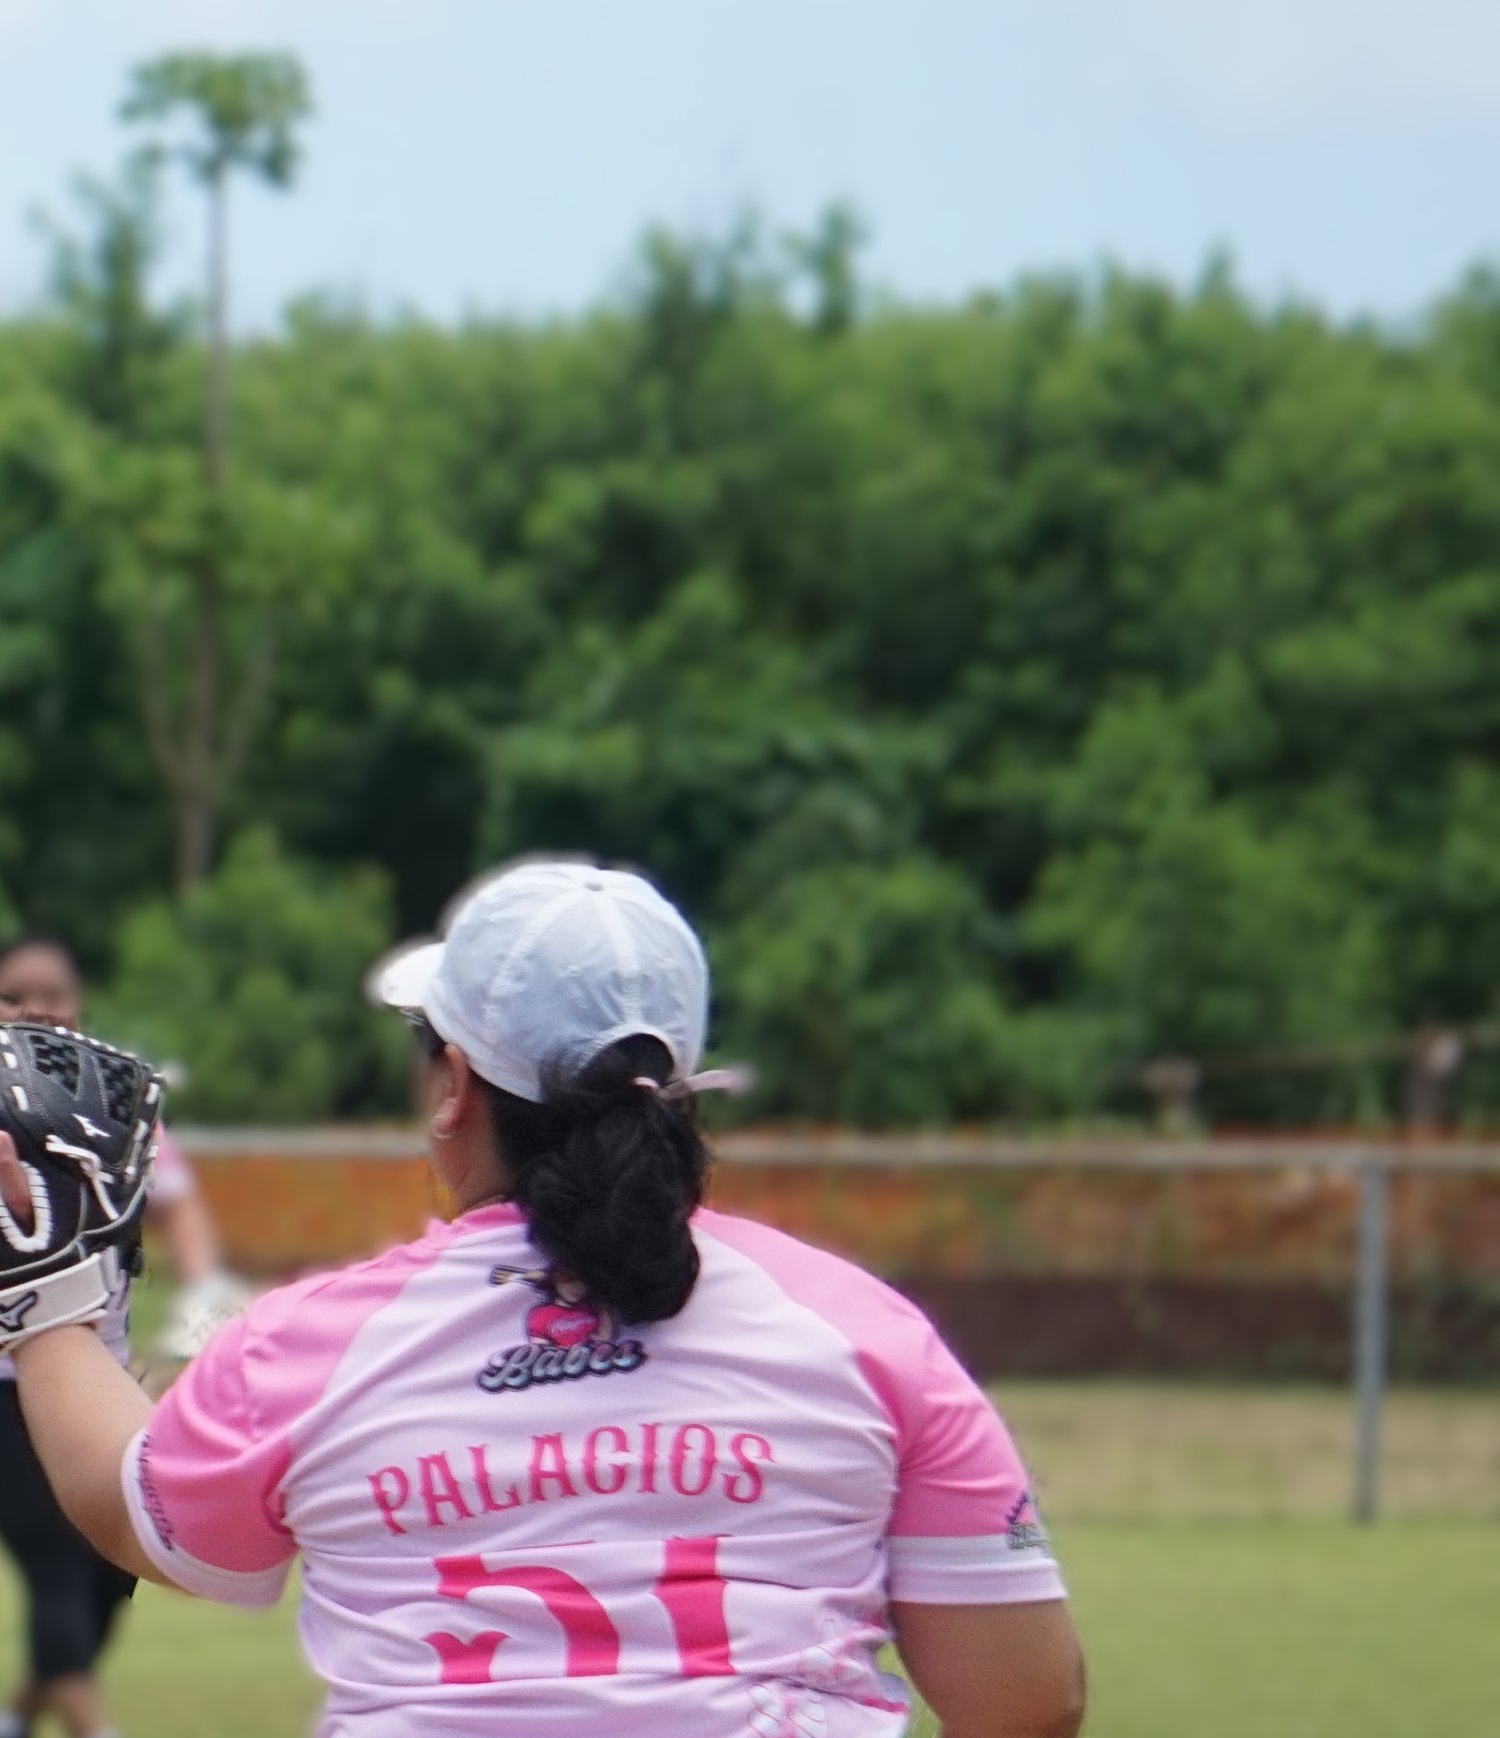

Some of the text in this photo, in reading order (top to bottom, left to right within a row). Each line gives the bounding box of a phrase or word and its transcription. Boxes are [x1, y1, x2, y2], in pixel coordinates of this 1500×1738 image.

[477, 1340, 647, 1393] Babes
[367, 1422, 776, 1537] PALACIOS
[422, 1533, 738, 1685] 51
